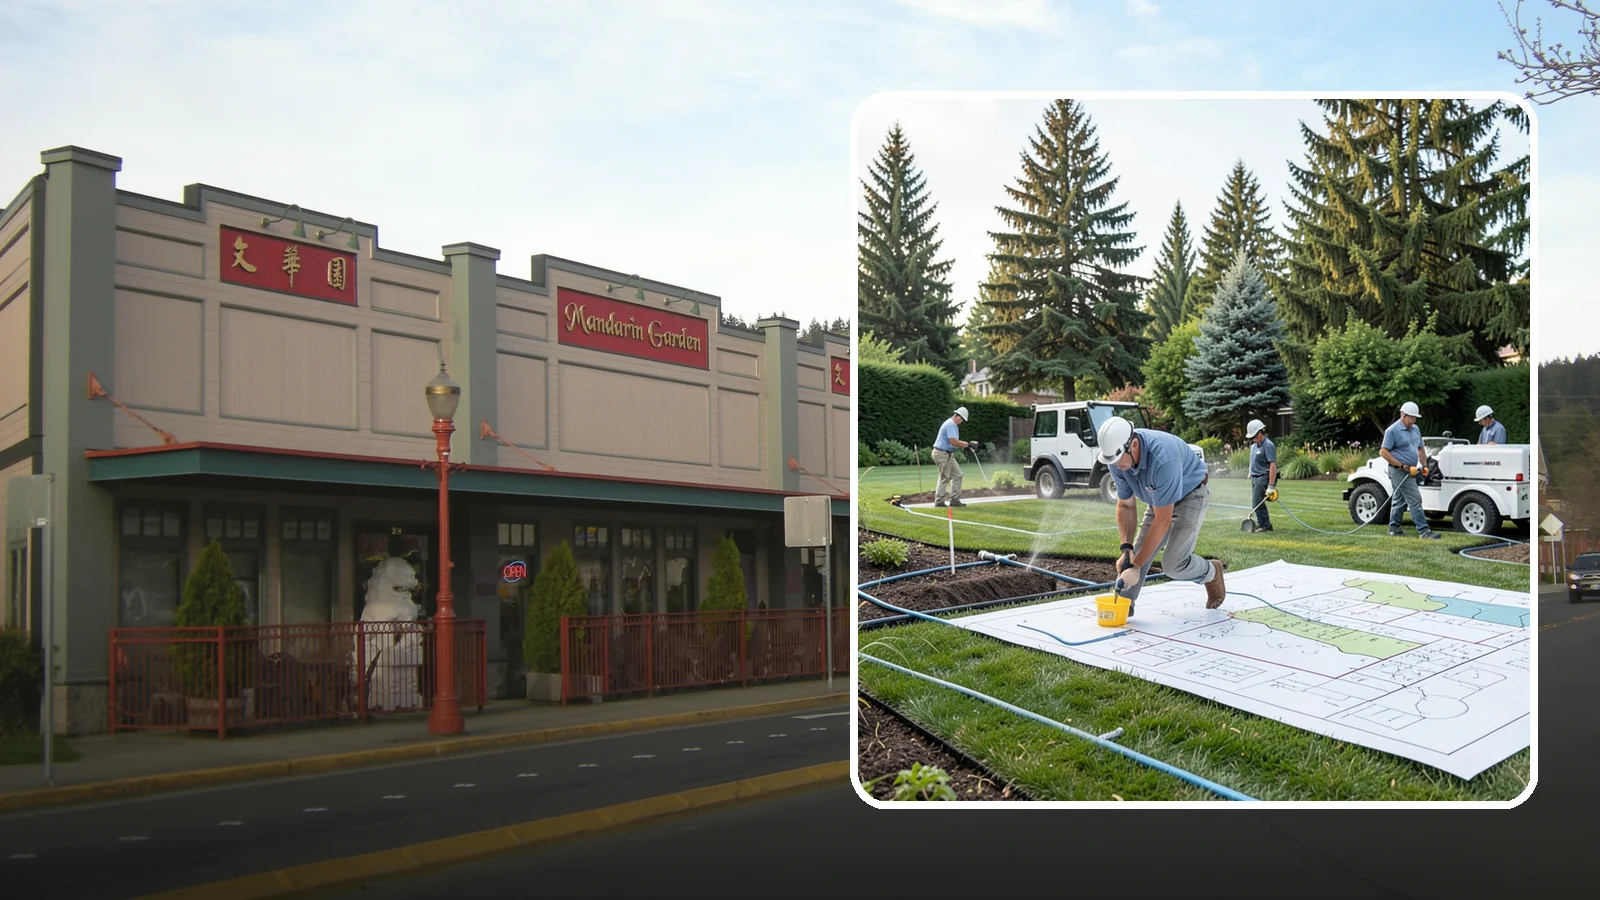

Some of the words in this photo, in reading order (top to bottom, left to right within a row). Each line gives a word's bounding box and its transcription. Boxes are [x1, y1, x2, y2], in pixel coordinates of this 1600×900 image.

[230, 235, 346, 291] 文華園
[564, 302, 644, 341] Mandarin
[648, 320, 702, 353] Garden
[503, 565, 527, 579] OPEN
